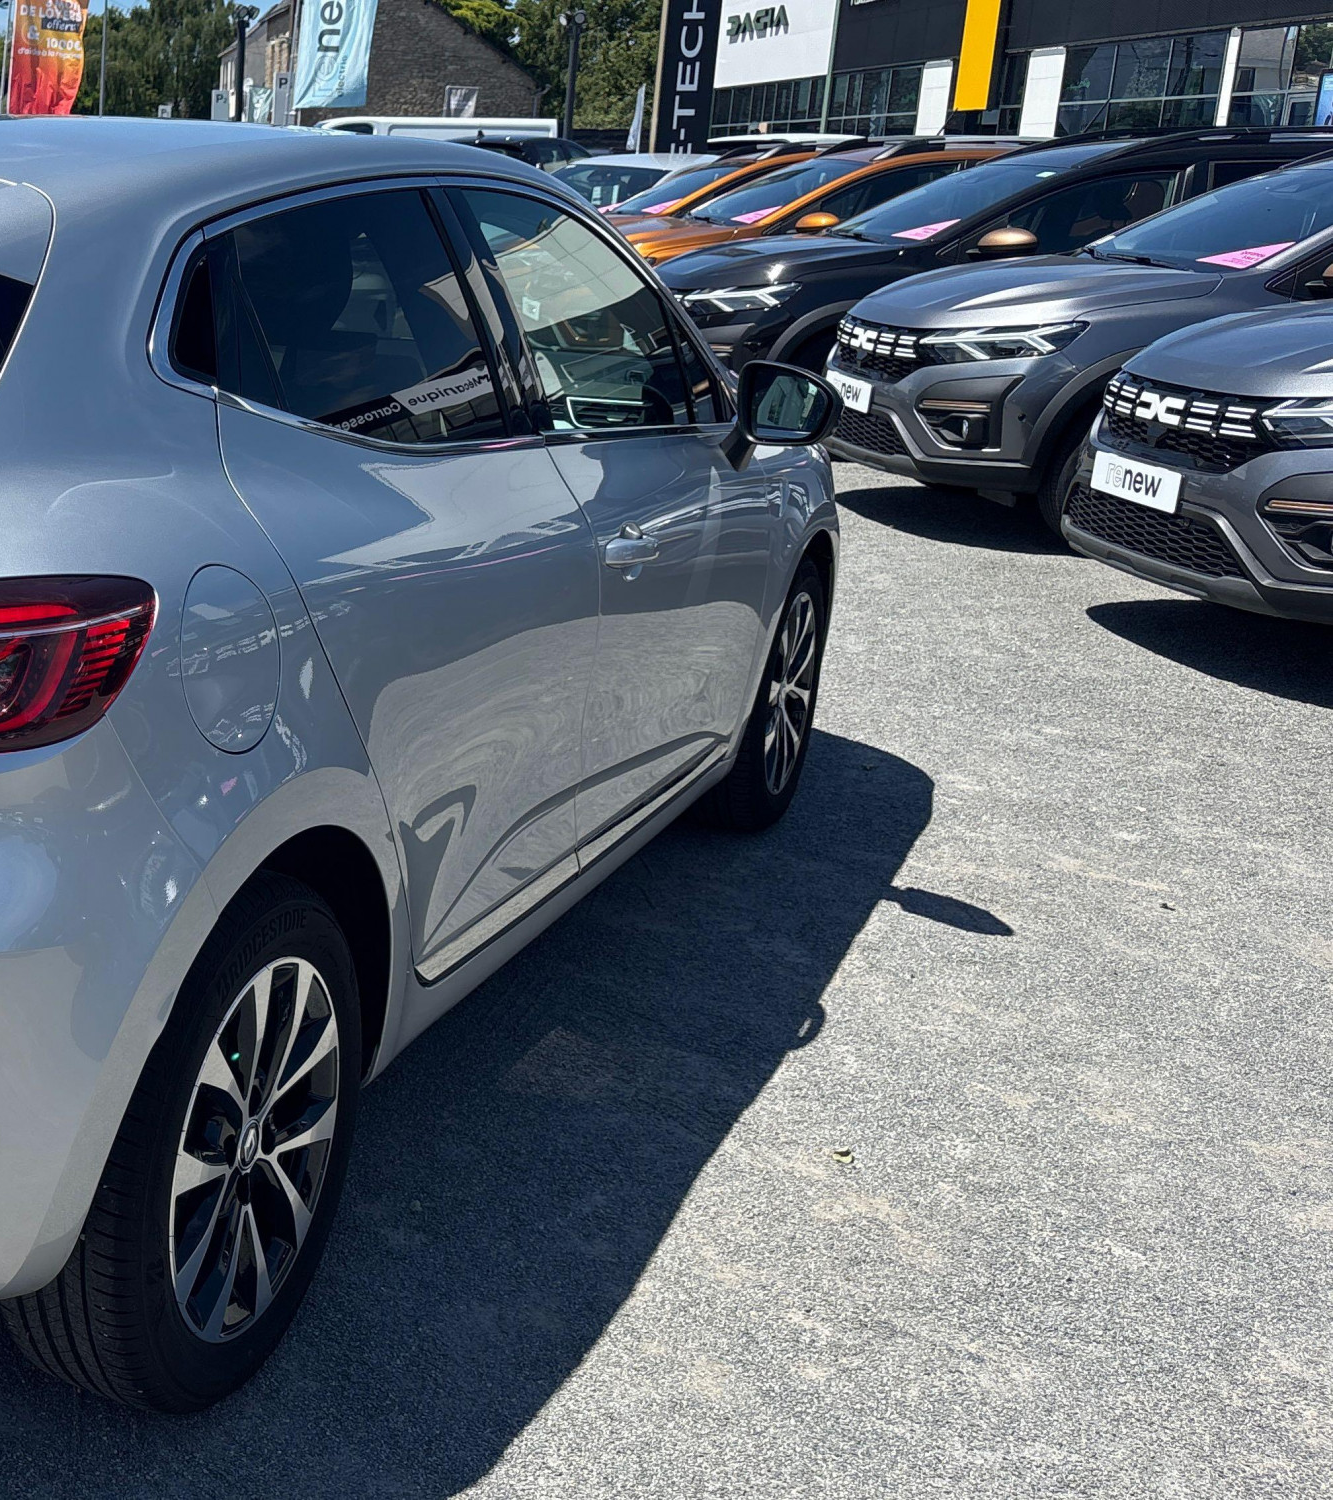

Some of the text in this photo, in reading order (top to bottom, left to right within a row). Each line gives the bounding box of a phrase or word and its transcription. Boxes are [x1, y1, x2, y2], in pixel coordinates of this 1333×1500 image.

[20, 4, 82, 22] DE LOYERS
[47, 38, 82, 52] 1000€
[670, 0, 706, 155] E-TECH
[1105, 462, 1162, 498] renew
